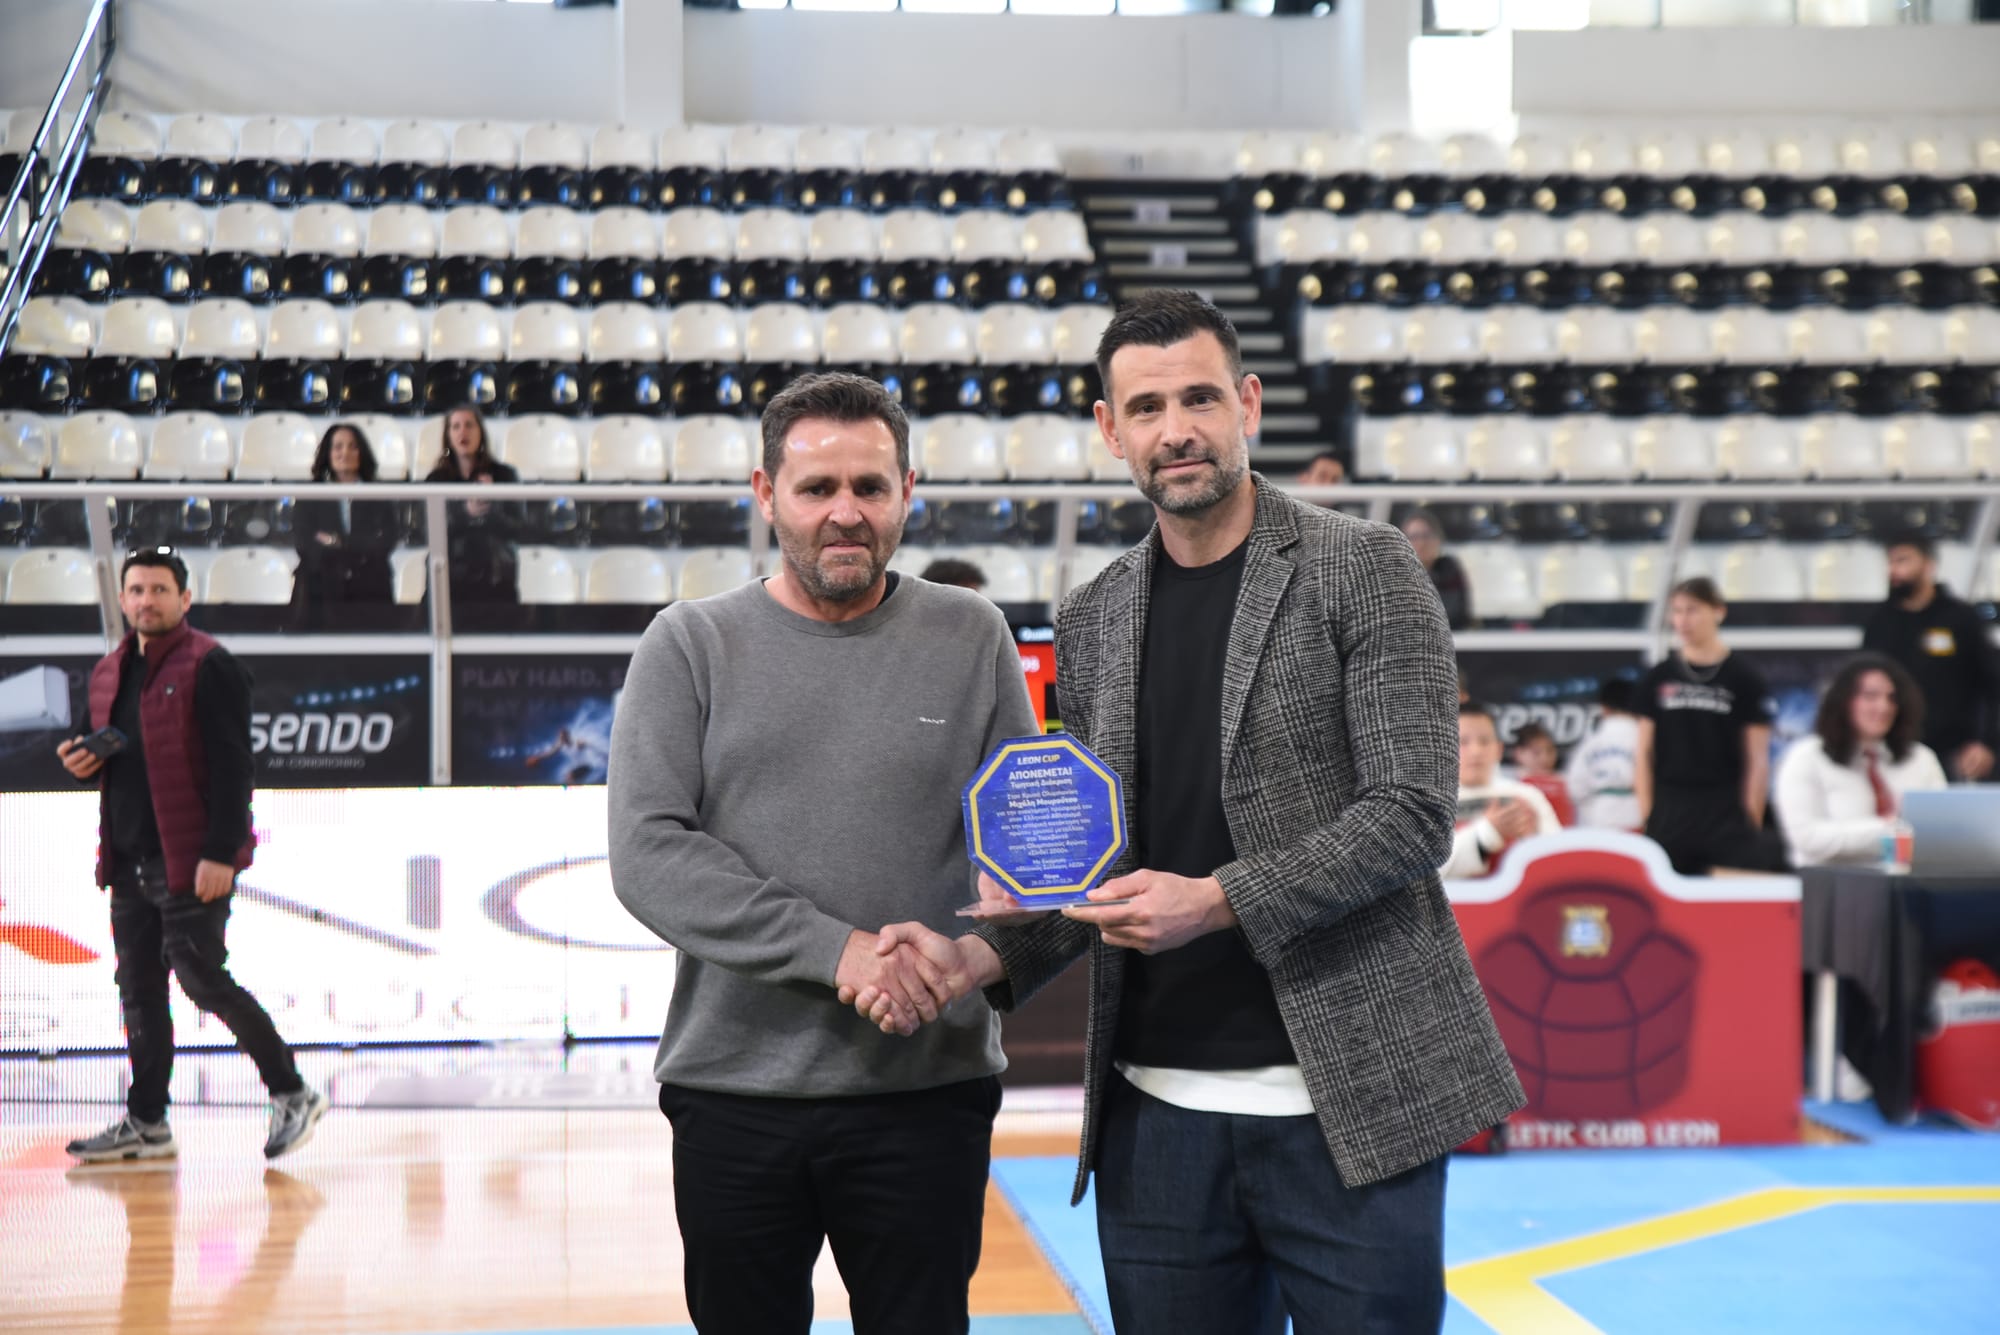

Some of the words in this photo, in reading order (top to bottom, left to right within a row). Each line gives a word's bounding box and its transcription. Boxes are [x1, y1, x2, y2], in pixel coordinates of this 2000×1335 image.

[462, 667, 520, 688] PLAY
[289, 756, 366, 769] CONDITIONING
[1017, 756, 1041, 765] LEON
[1042, 754, 1061, 763] CUP
[1009, 767, 1072, 780] ΑΠΟΝΕΜΕΤΑΙ
[1654, 1118, 1721, 1147] LEON
